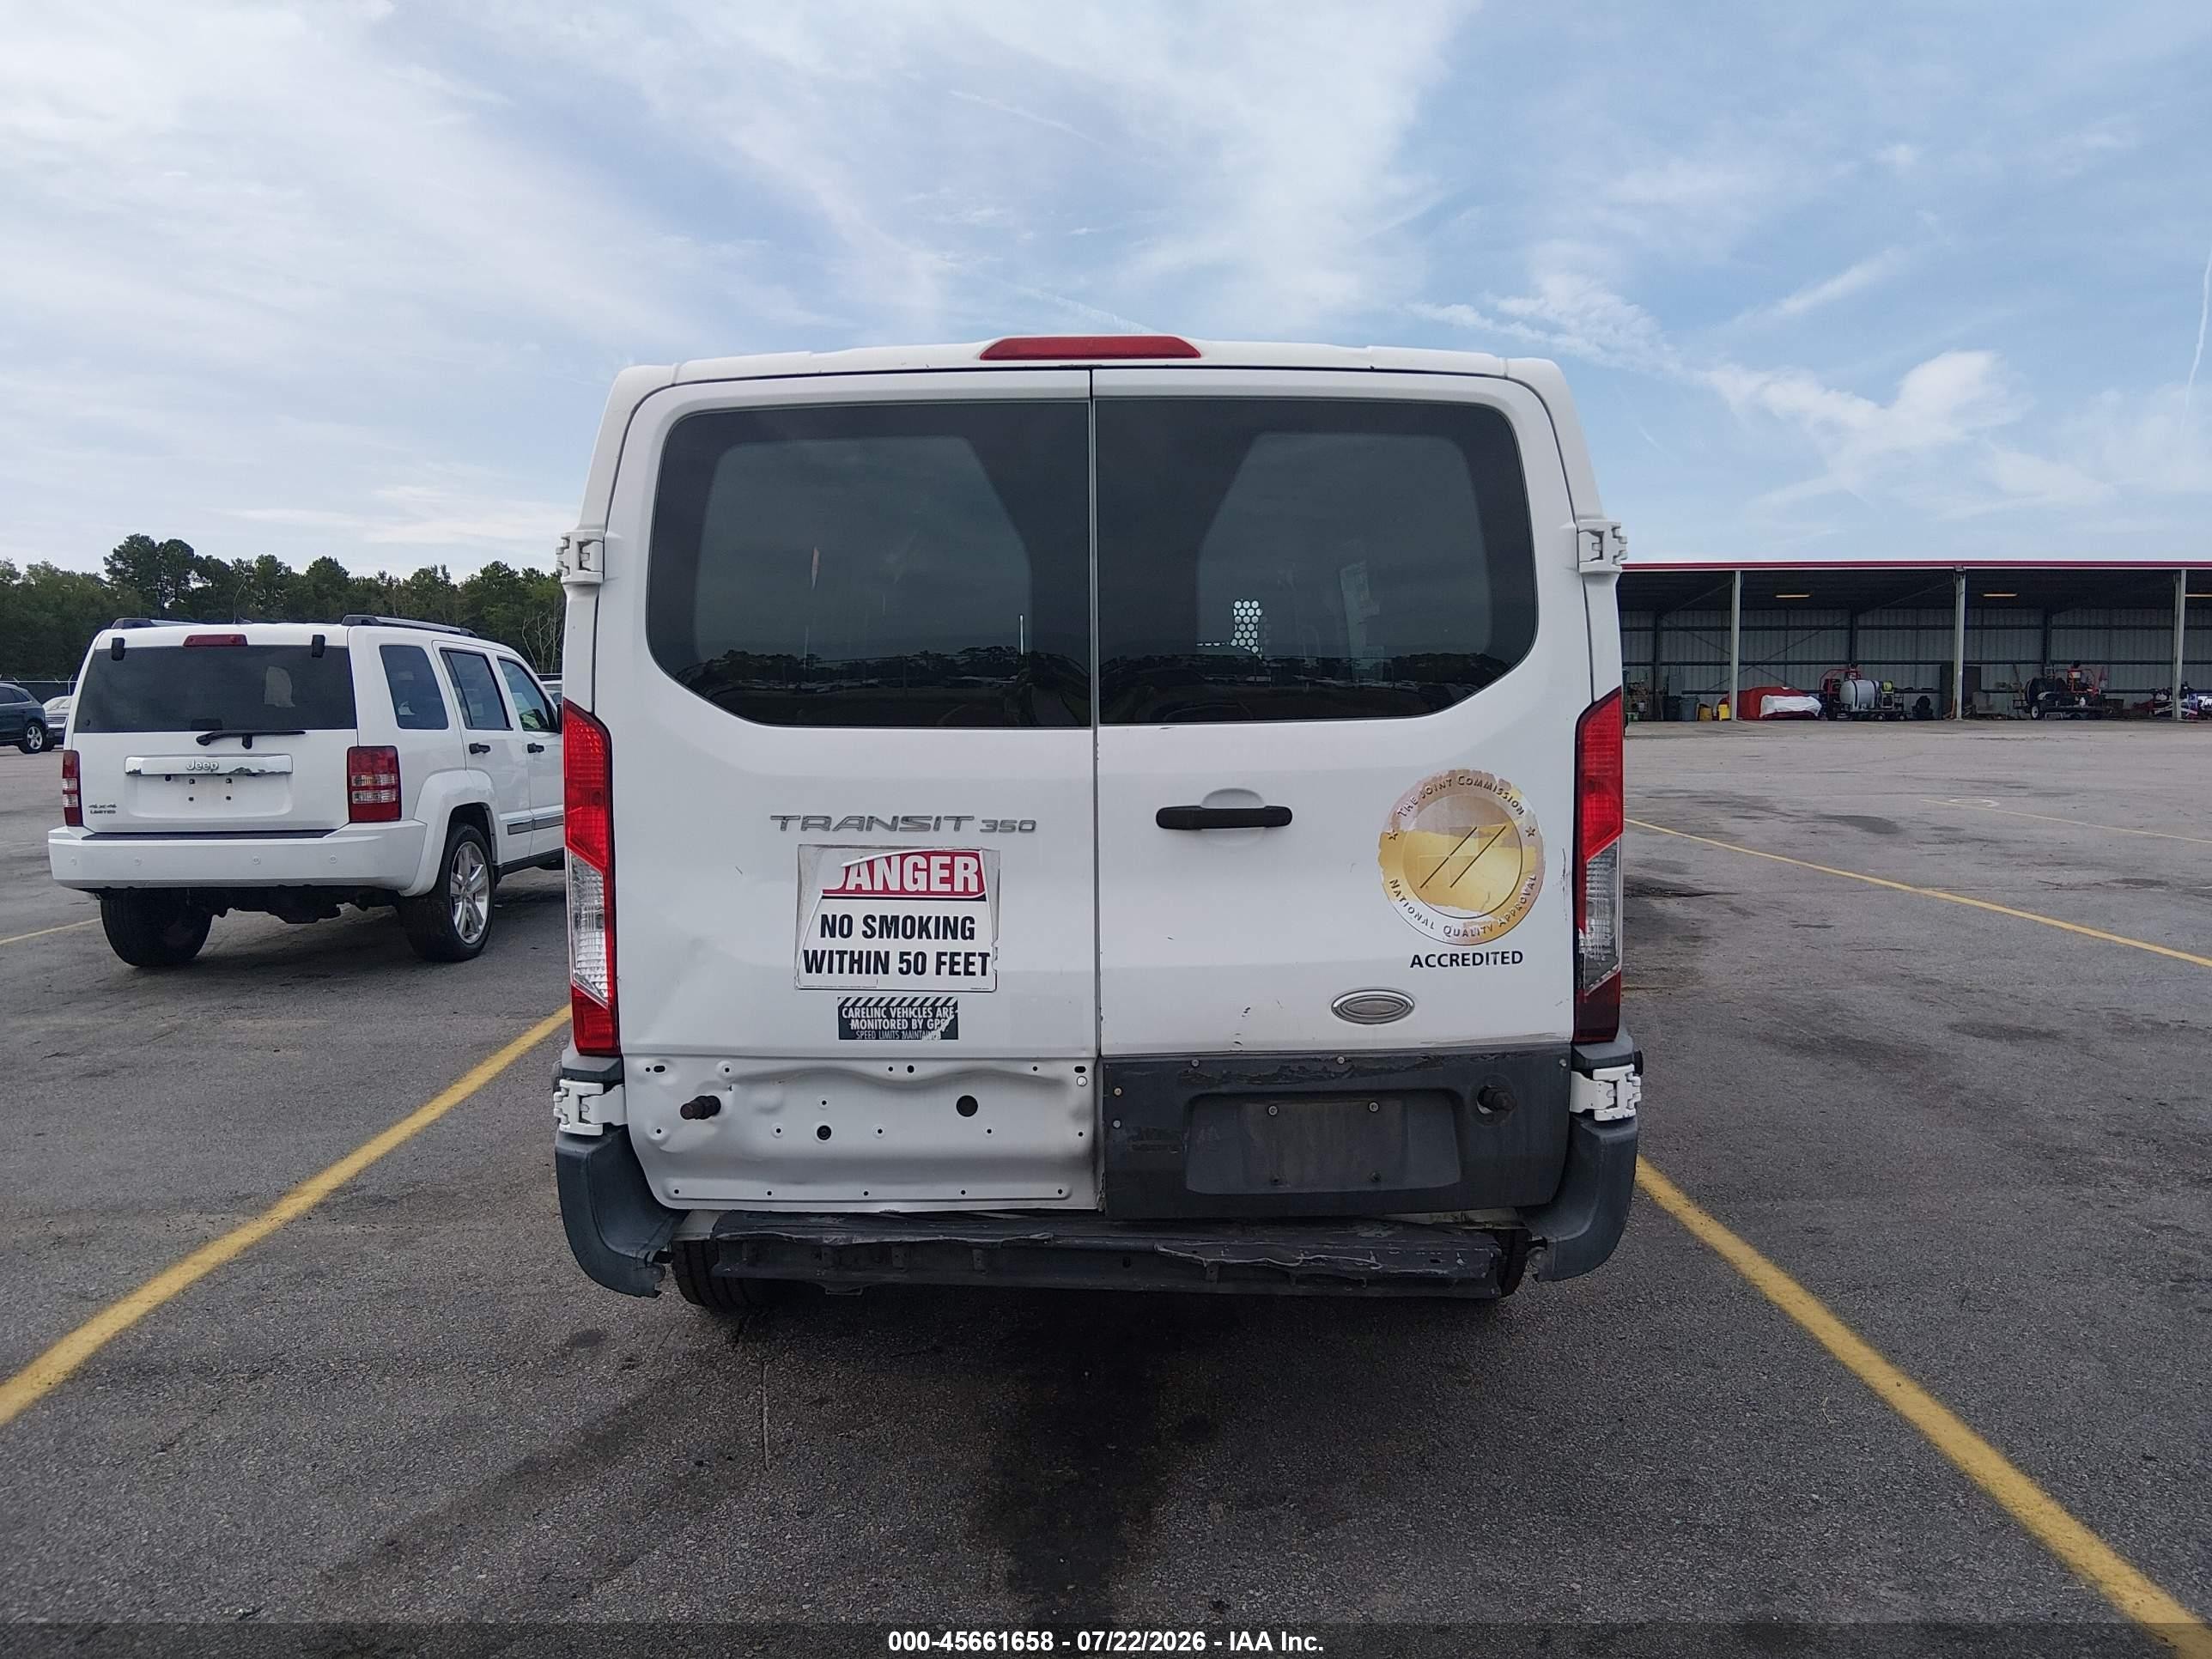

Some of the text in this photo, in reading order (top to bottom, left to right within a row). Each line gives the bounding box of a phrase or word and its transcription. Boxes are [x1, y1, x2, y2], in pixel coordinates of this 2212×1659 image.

[185, 759, 219, 773] Jeep
[1397, 775, 1524, 817] THE JOINT COMMISSION
[770, 815, 1036, 833] TRANSIT 350
[1389, 873, 1537, 939] NATIONAL QUALITY APPROVAL
[820, 914, 975, 940] NO SMOKING
[803, 949, 990, 977] WITHIN 50 FEET
[1409, 950, 1523, 969] ACCREDITED
[890, 1006, 933, 1018] VEHICLES
[935, 1006, 954, 1018] ARE
[850, 1018, 908, 1030] MONITORED
[911, 1018, 925, 1030] BY
[855, 1030, 877, 1040] SPEED
[878, 1030, 900, 1040] LIMITS
